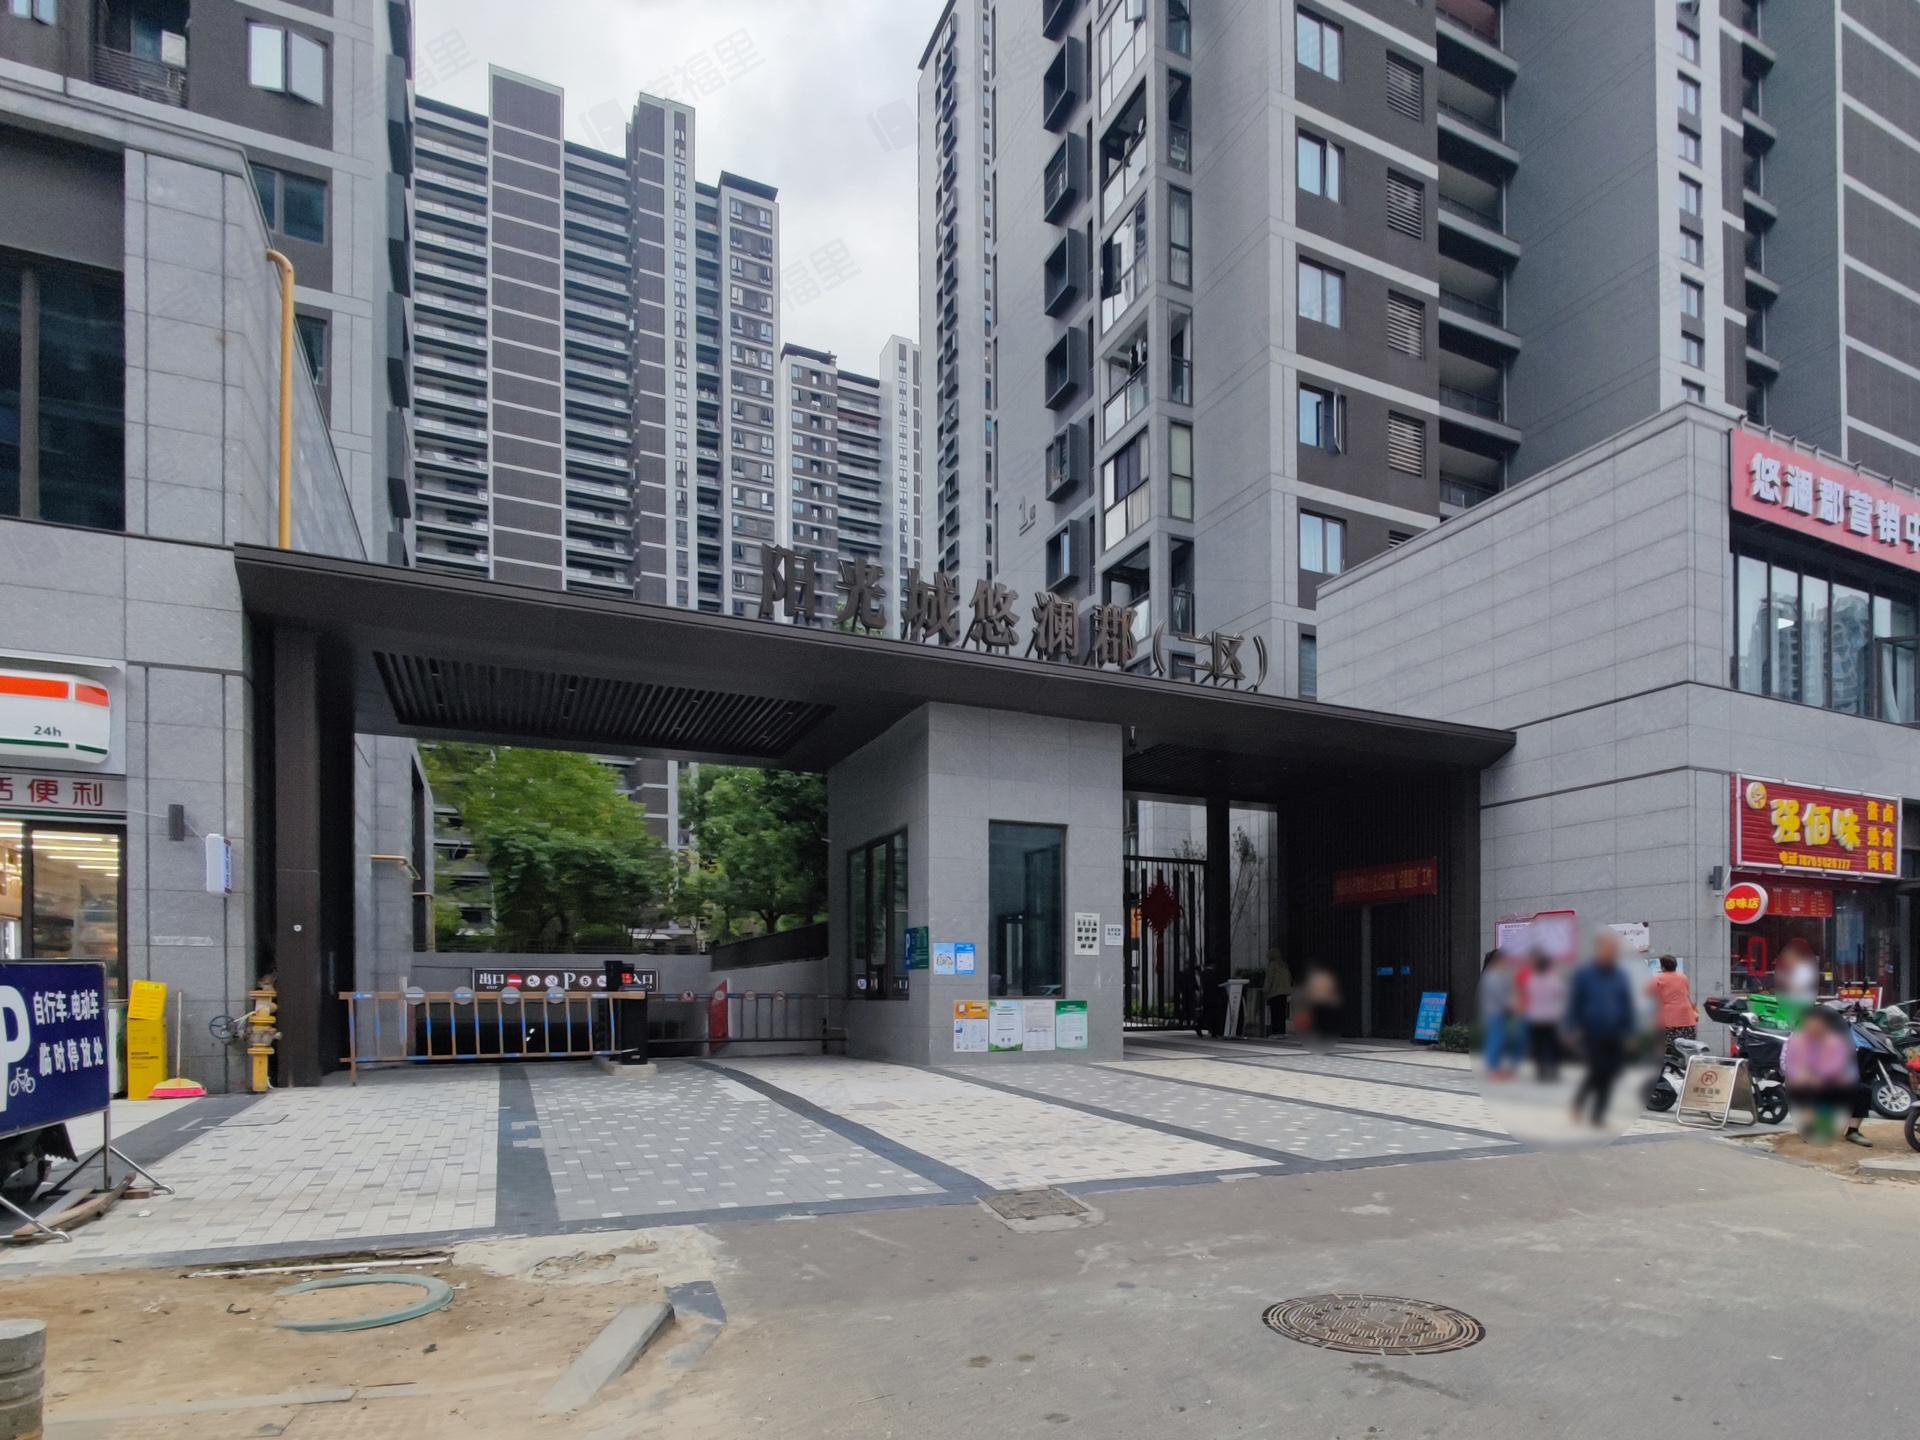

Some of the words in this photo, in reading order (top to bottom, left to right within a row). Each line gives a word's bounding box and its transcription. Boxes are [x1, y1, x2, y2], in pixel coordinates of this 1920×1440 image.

[33, 725, 62, 737] 24h
[480, 973, 504, 985] 出口
[563, 972, 577, 991] P
[40, 1036, 103, 1077] 临时停放处
